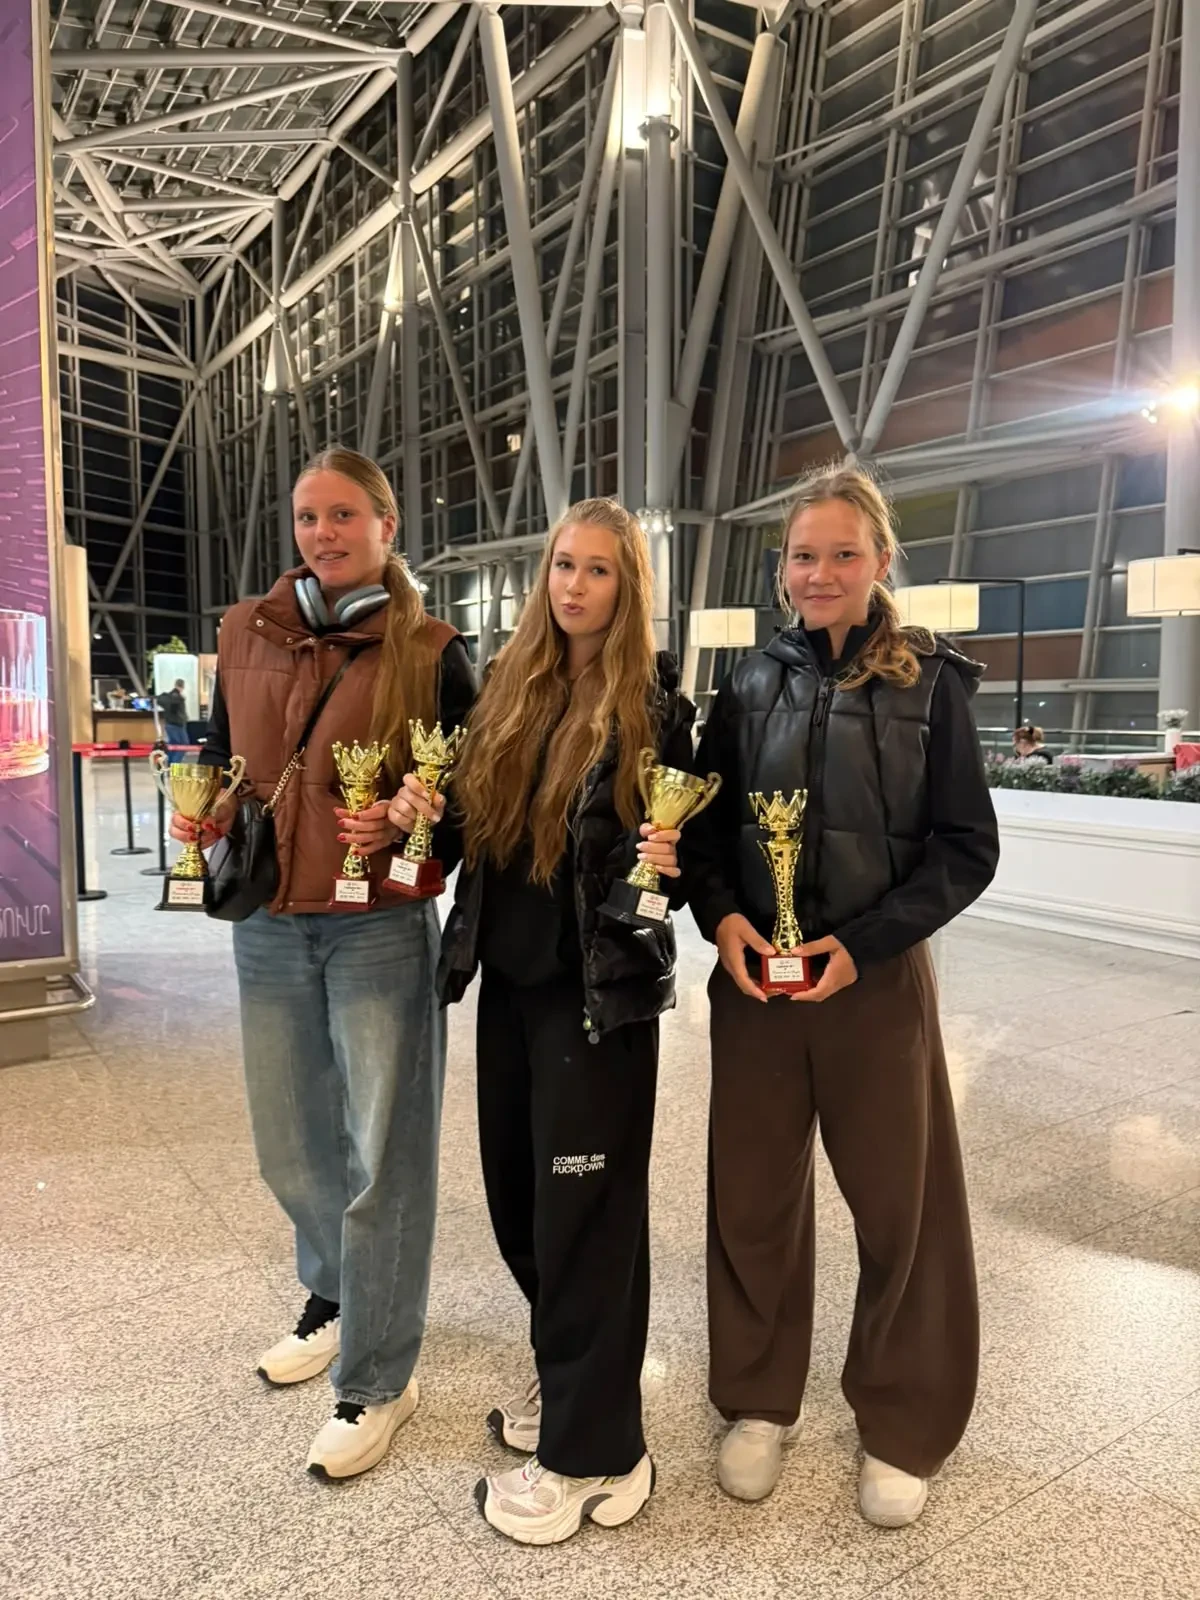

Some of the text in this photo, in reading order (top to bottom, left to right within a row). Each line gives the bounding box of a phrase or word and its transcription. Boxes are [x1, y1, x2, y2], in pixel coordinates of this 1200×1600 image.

[553, 1153, 606, 1165] COMME des
[552, 1161, 605, 1174] FUCKDOWN
